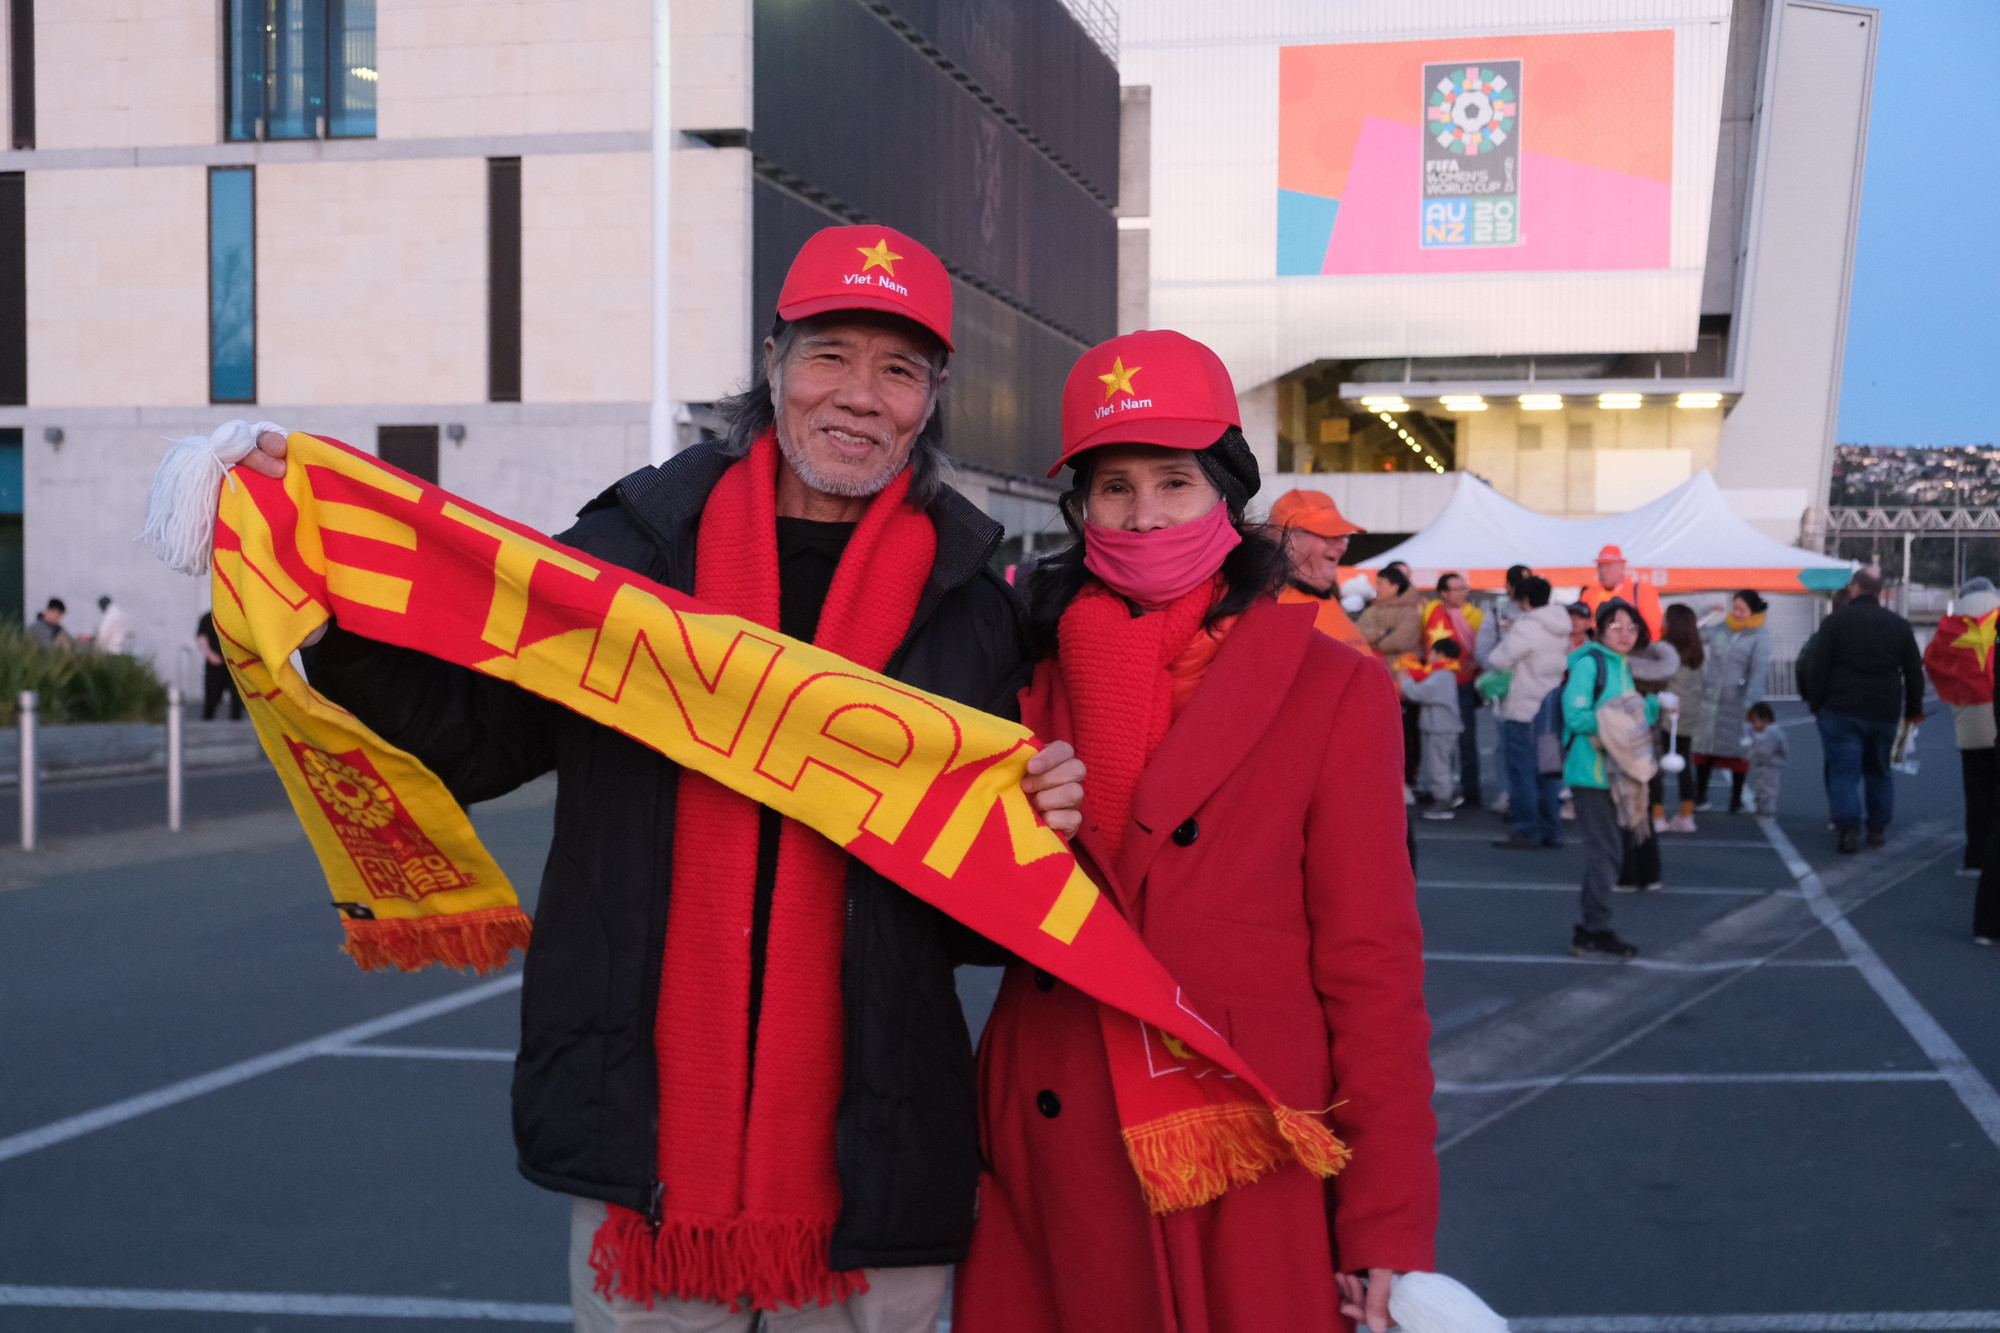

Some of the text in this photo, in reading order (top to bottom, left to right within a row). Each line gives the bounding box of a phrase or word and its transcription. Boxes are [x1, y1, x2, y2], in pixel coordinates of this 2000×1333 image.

[1426, 159, 1459, 173] FIFA
[1426, 181, 1501, 195] WORLD CUP
[1427, 202, 1467, 224] AU
[1426, 222, 1465, 243] NZ
[842, 274, 909, 296] Viet Nam
[1094, 398, 1152, 420] Viet Nam
